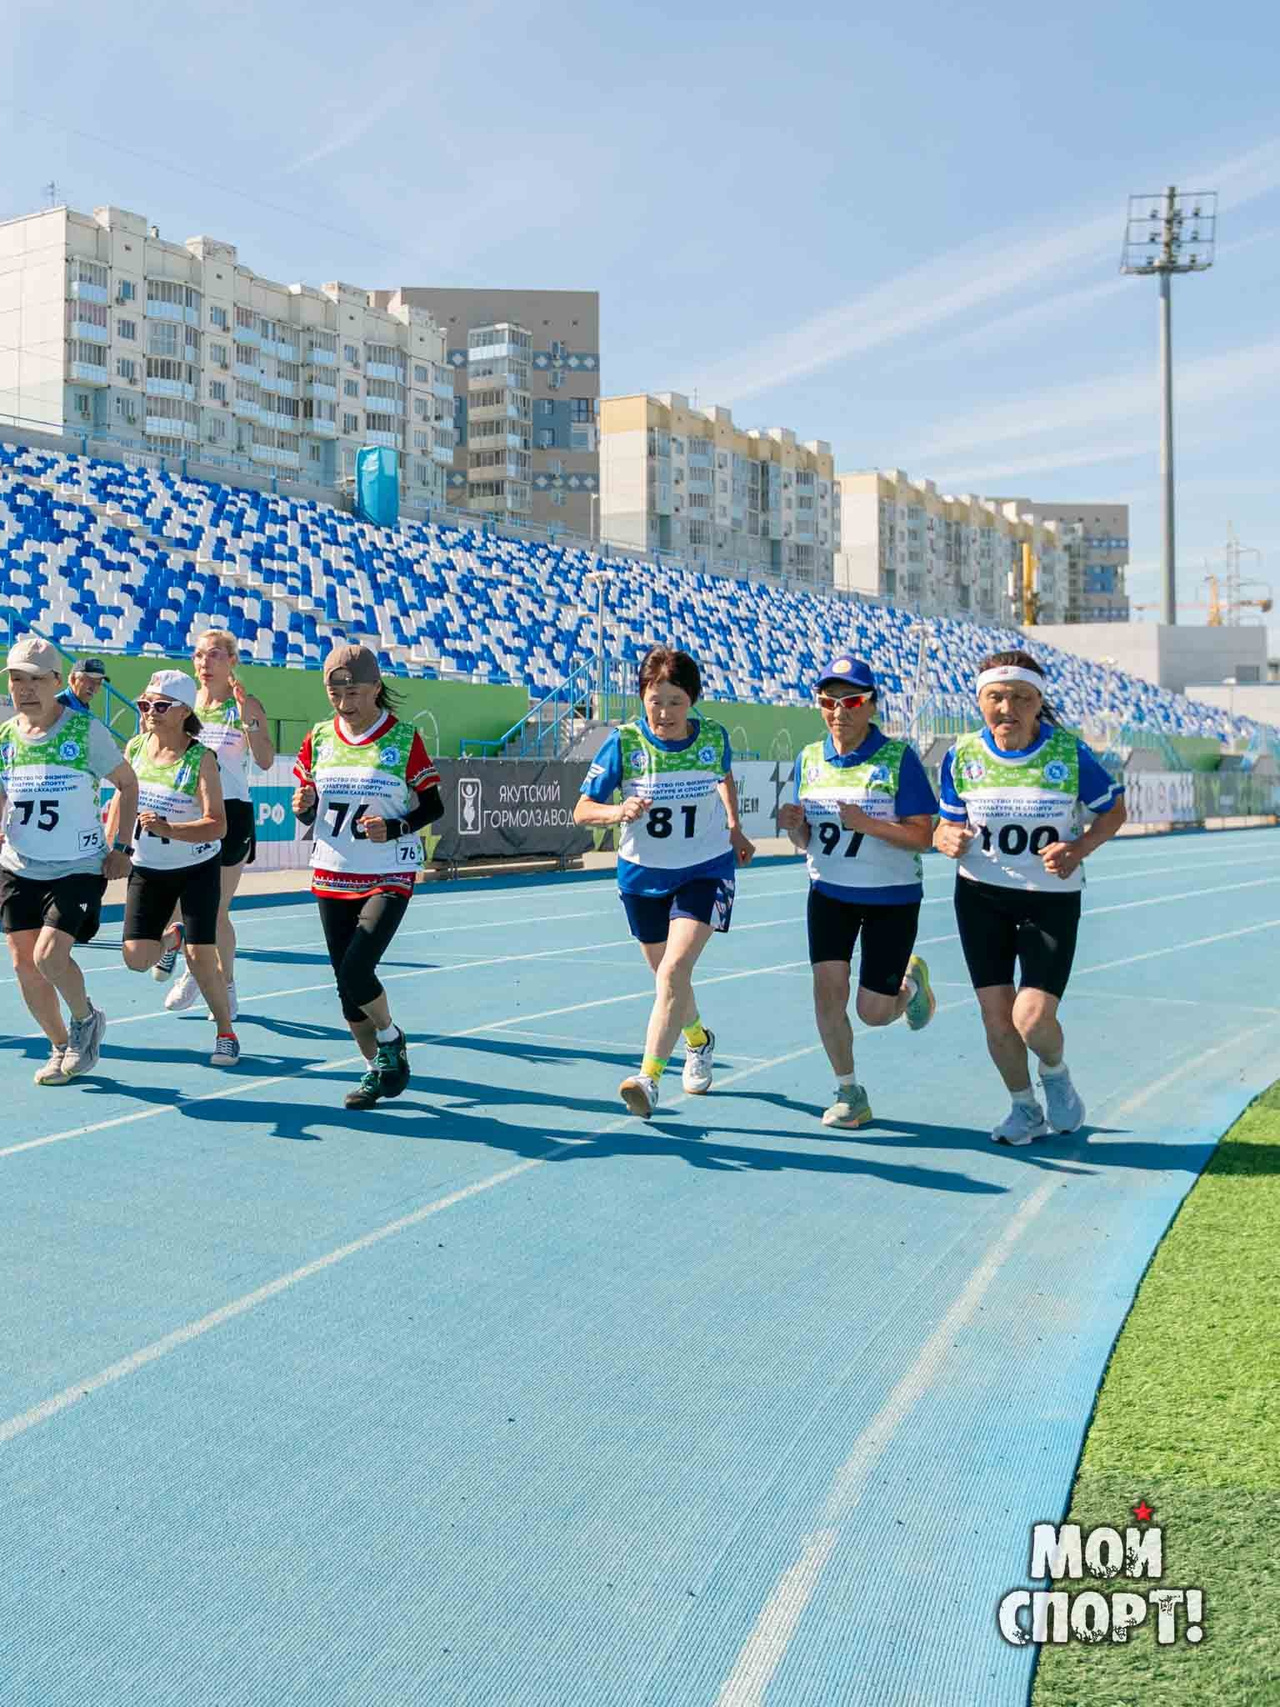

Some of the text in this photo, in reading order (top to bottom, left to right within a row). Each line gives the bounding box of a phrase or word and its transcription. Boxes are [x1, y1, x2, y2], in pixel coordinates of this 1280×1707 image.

[499, 780, 561, 803] ЯКУТСКИЙ
[13, 800, 59, 832] 75
[328, 802, 370, 840] 76
[483, 809, 576, 829] ГОРМОЛЗАВОД
[646, 805, 697, 839] 81
[83, 833, 99, 847] 75
[400, 846, 416, 861] 76
[819, 822, 864, 857] 97
[979, 823, 1059, 856] 100
